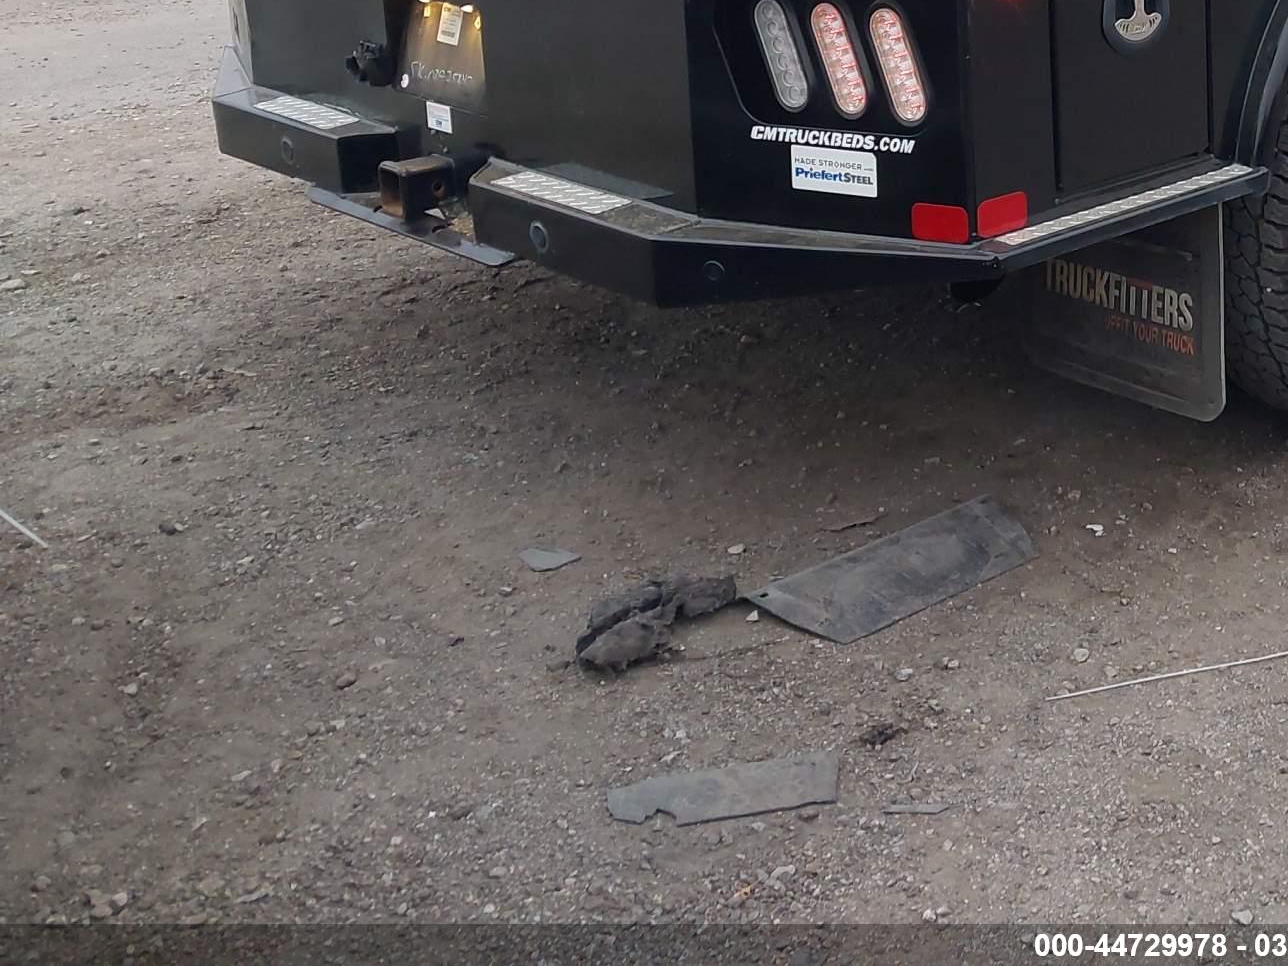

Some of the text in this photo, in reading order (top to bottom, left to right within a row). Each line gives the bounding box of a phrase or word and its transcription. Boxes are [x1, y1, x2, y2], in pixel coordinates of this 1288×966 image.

[750, 125, 915, 154] CMTRUCKBEDS.COM
[794, 157, 816, 166] MADE
[818, 159, 862, 171] STRONGER
[1046, 258, 1194, 332] TRUCKFITTERS
[1133, 321, 1159, 345] YOUR
[1161, 329, 1195, 355] TRUCK
